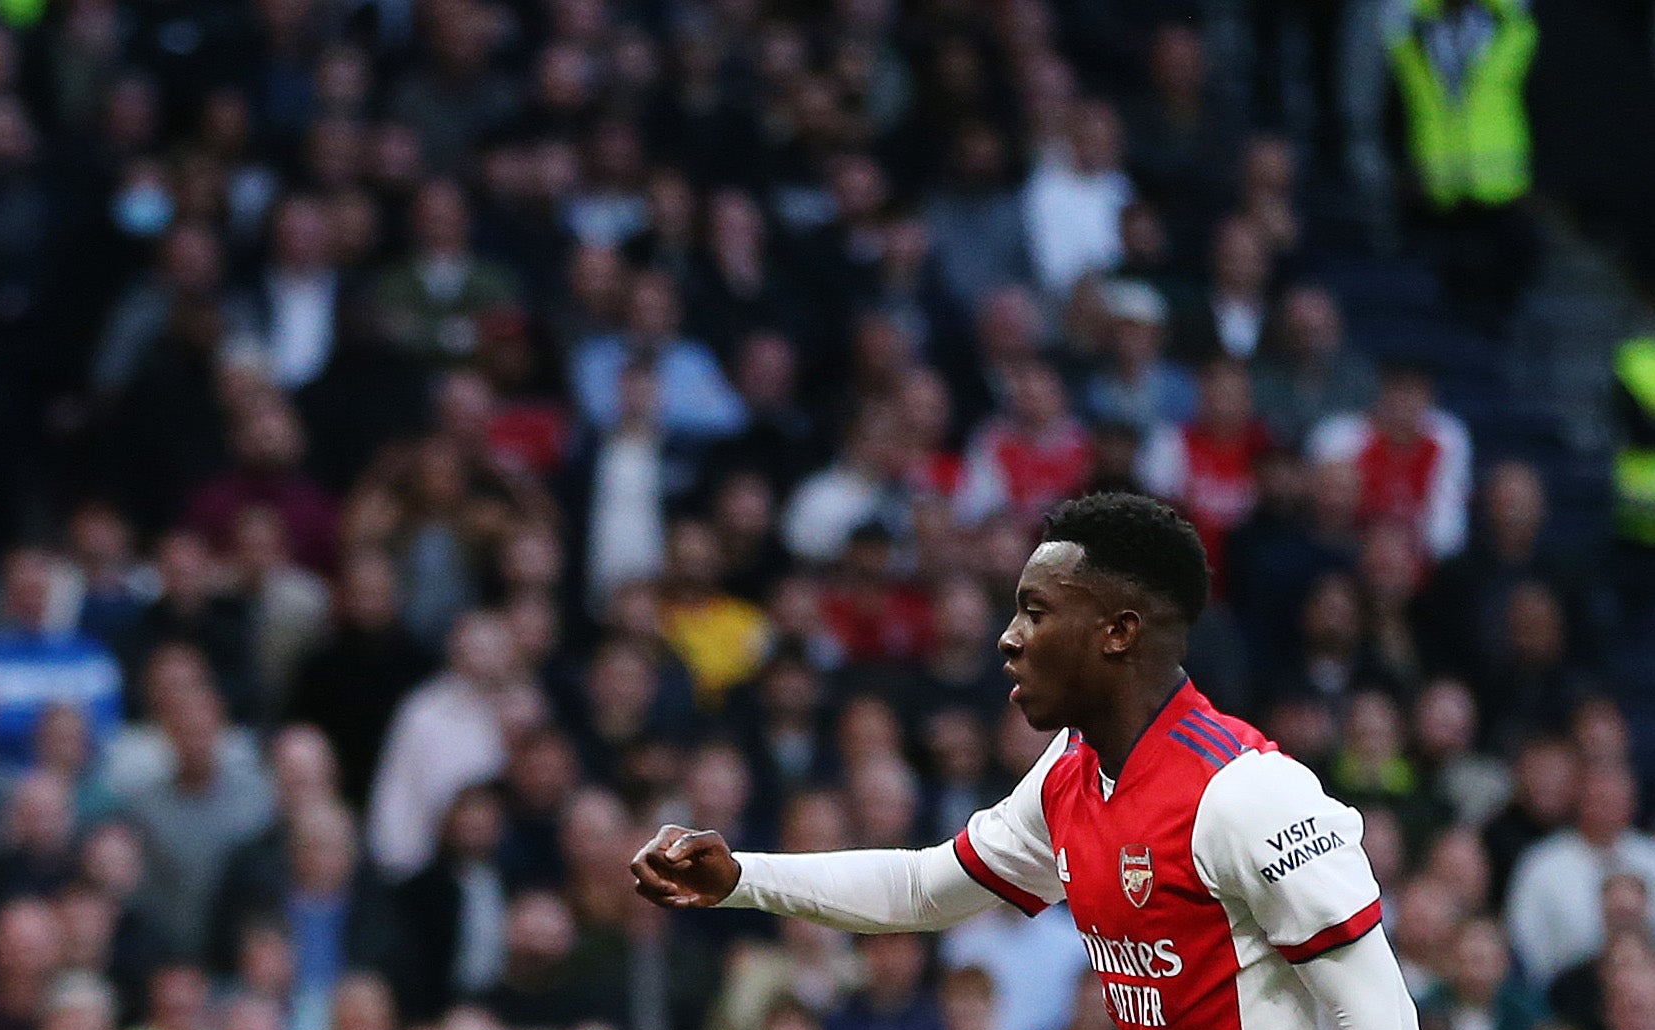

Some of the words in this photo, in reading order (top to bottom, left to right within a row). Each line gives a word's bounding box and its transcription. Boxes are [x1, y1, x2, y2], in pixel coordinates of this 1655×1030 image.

[1260, 830, 1345, 884] RWANDA
[1266, 816, 1316, 852] VISIT
[1080, 925, 1183, 978] mirates
